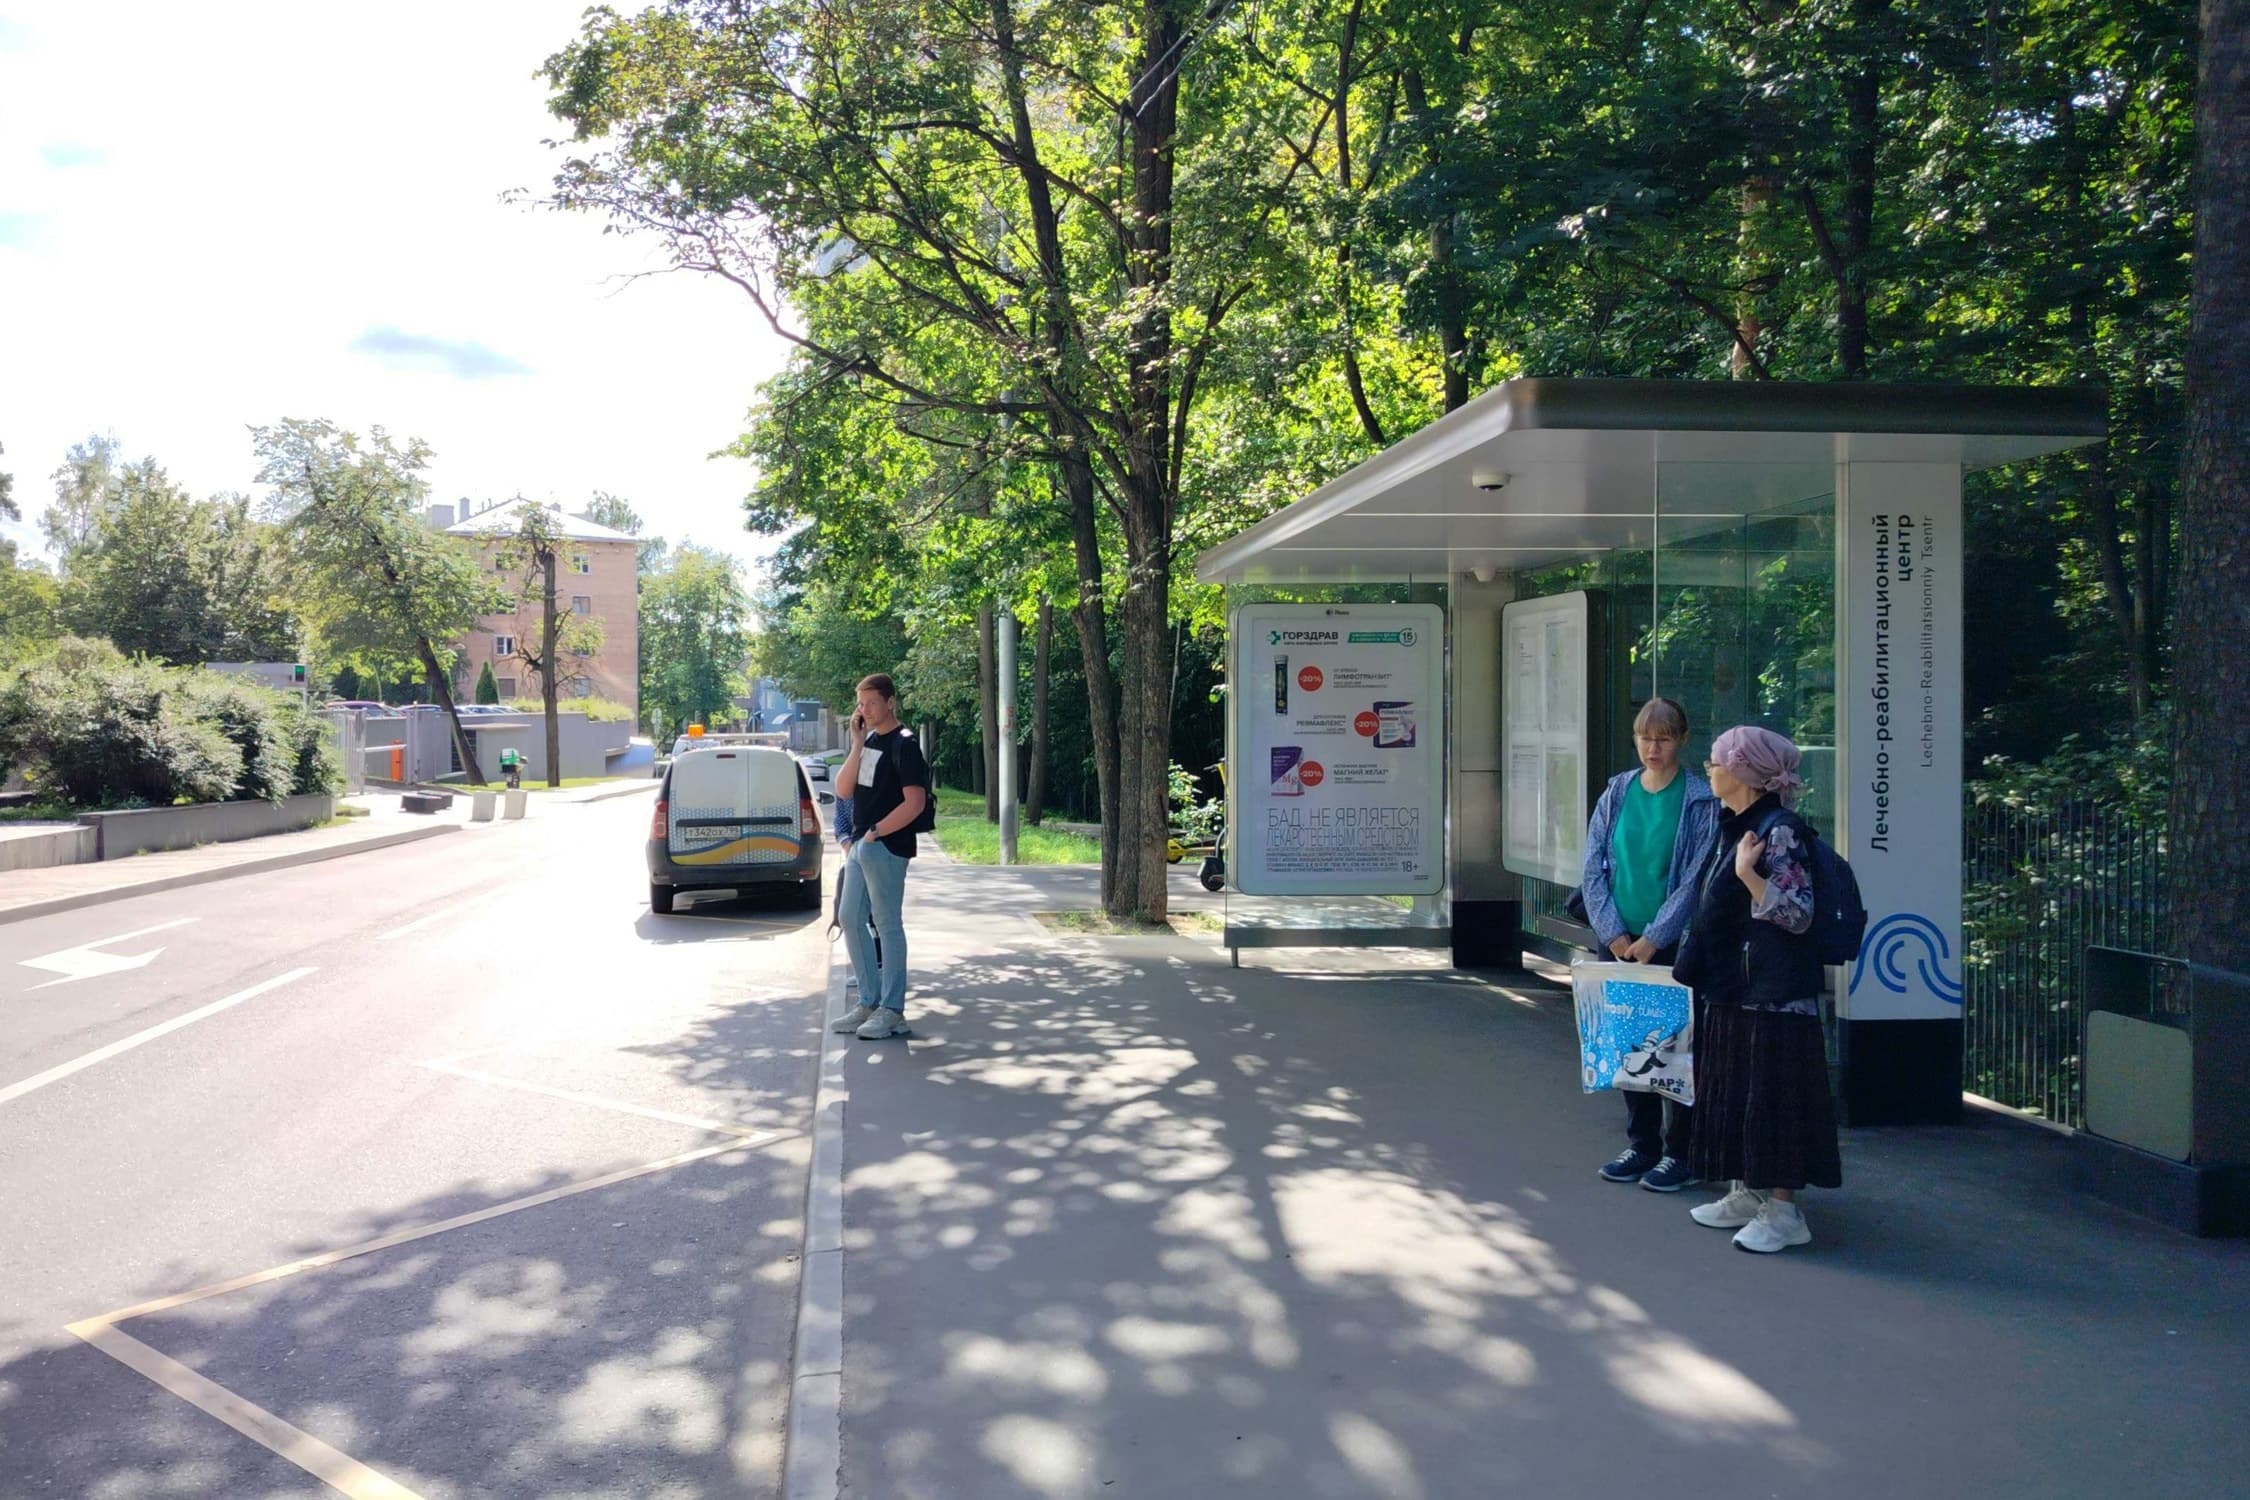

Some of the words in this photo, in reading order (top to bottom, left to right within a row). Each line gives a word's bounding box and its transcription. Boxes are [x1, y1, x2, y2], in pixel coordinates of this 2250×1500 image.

[1920, 514, 1934, 561] Tsentr
[1898, 514, 1915, 582] центр
[1282, 631, 1339, 641] ГОРЗДРАВ
[1402, 632, 1413, 641] 15
[1921, 566, 1936, 768] Lechebno-Reabilitatsionniy
[1300, 674, 1322, 683] -20%
[1871, 514, 1893, 853] Лечебно-реабилитационный
[1355, 720, 1379, 729] -20%
[1300, 769, 1323, 778] -20%
[1267, 807, 1305, 828] БАД.
[1310, 807, 1331, 827] НЕ
[1335, 807, 1420, 827] ЯВЛЯЕТСЯ
[1266, 827, 1356, 847] ЛЕКАРСТВЕННЫМ
[1358, 827, 1420, 847] СРЕДСТВОМ
[1402, 861, 1419, 873] 18+
